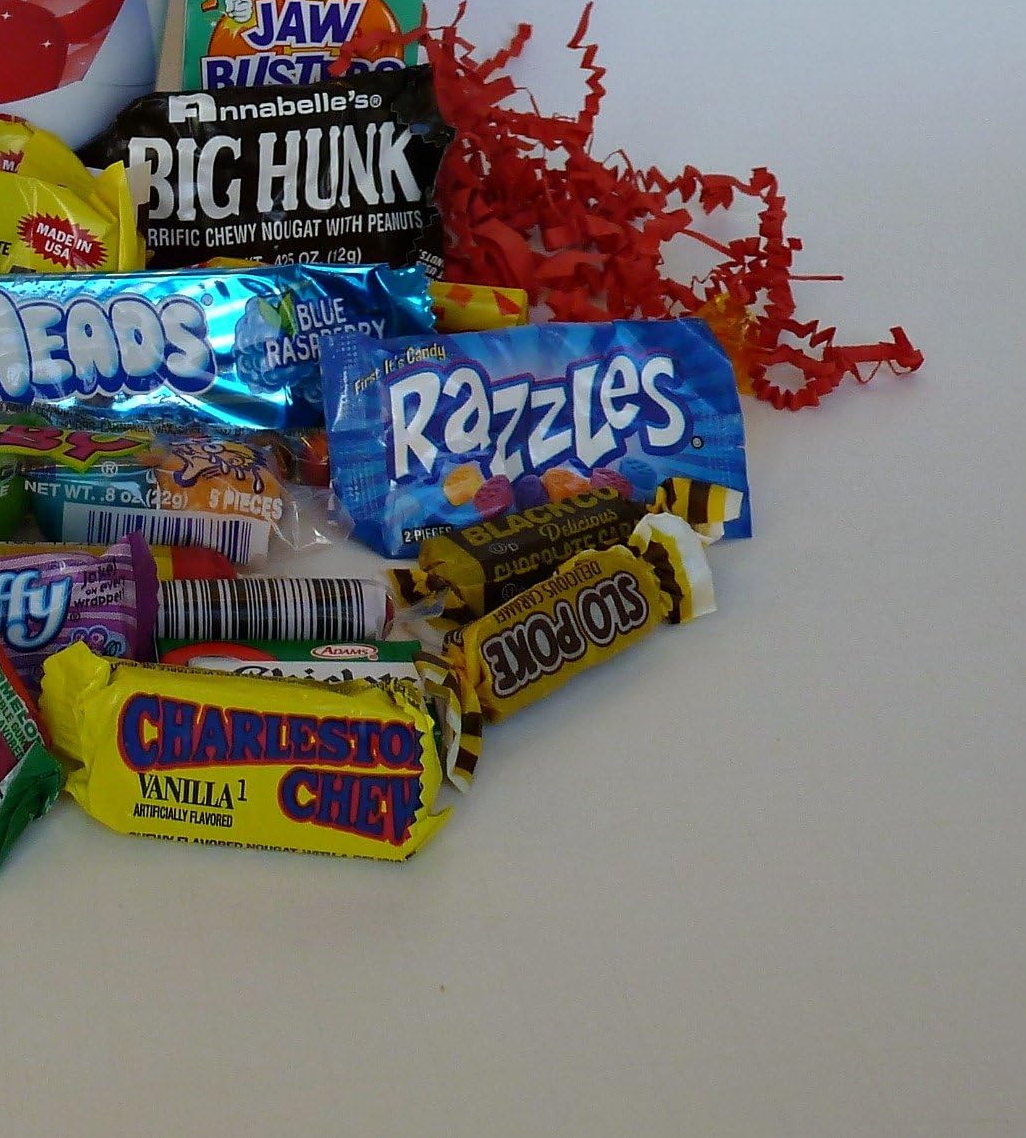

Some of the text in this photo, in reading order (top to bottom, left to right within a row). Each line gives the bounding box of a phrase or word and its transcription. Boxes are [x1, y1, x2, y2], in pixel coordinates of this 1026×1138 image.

[127, 121, 423, 222] BIG HUNK
[36, 222, 92, 254] MADE IN
[204, 223, 257, 247] CHEWY
[261, 219, 322, 240] NOUGAT
[326, 214, 363, 236] WITH
[367, 210, 424, 234] PEANUTS
[45, 241, 70, 259] USA
[326, 247, 362, 266] (12g)
[296, 297, 347, 332] BLUE
[353, 342, 447, 396] First It's Candy
[24, 480, 61, 497] NET
[63, 484, 96, 502] WT.
[224, 491, 283, 520] PIECES
[538, 507, 620, 542] Delicious
[543, 560, 603, 599] DELICIOUS
[315, 645, 368, 657] ADAMS
[480, 571, 649, 699] SLO POKE
[137, 772, 234, 811] VANILLA
[133, 802, 234, 829] ARTIFICIALLY FLAVORED
